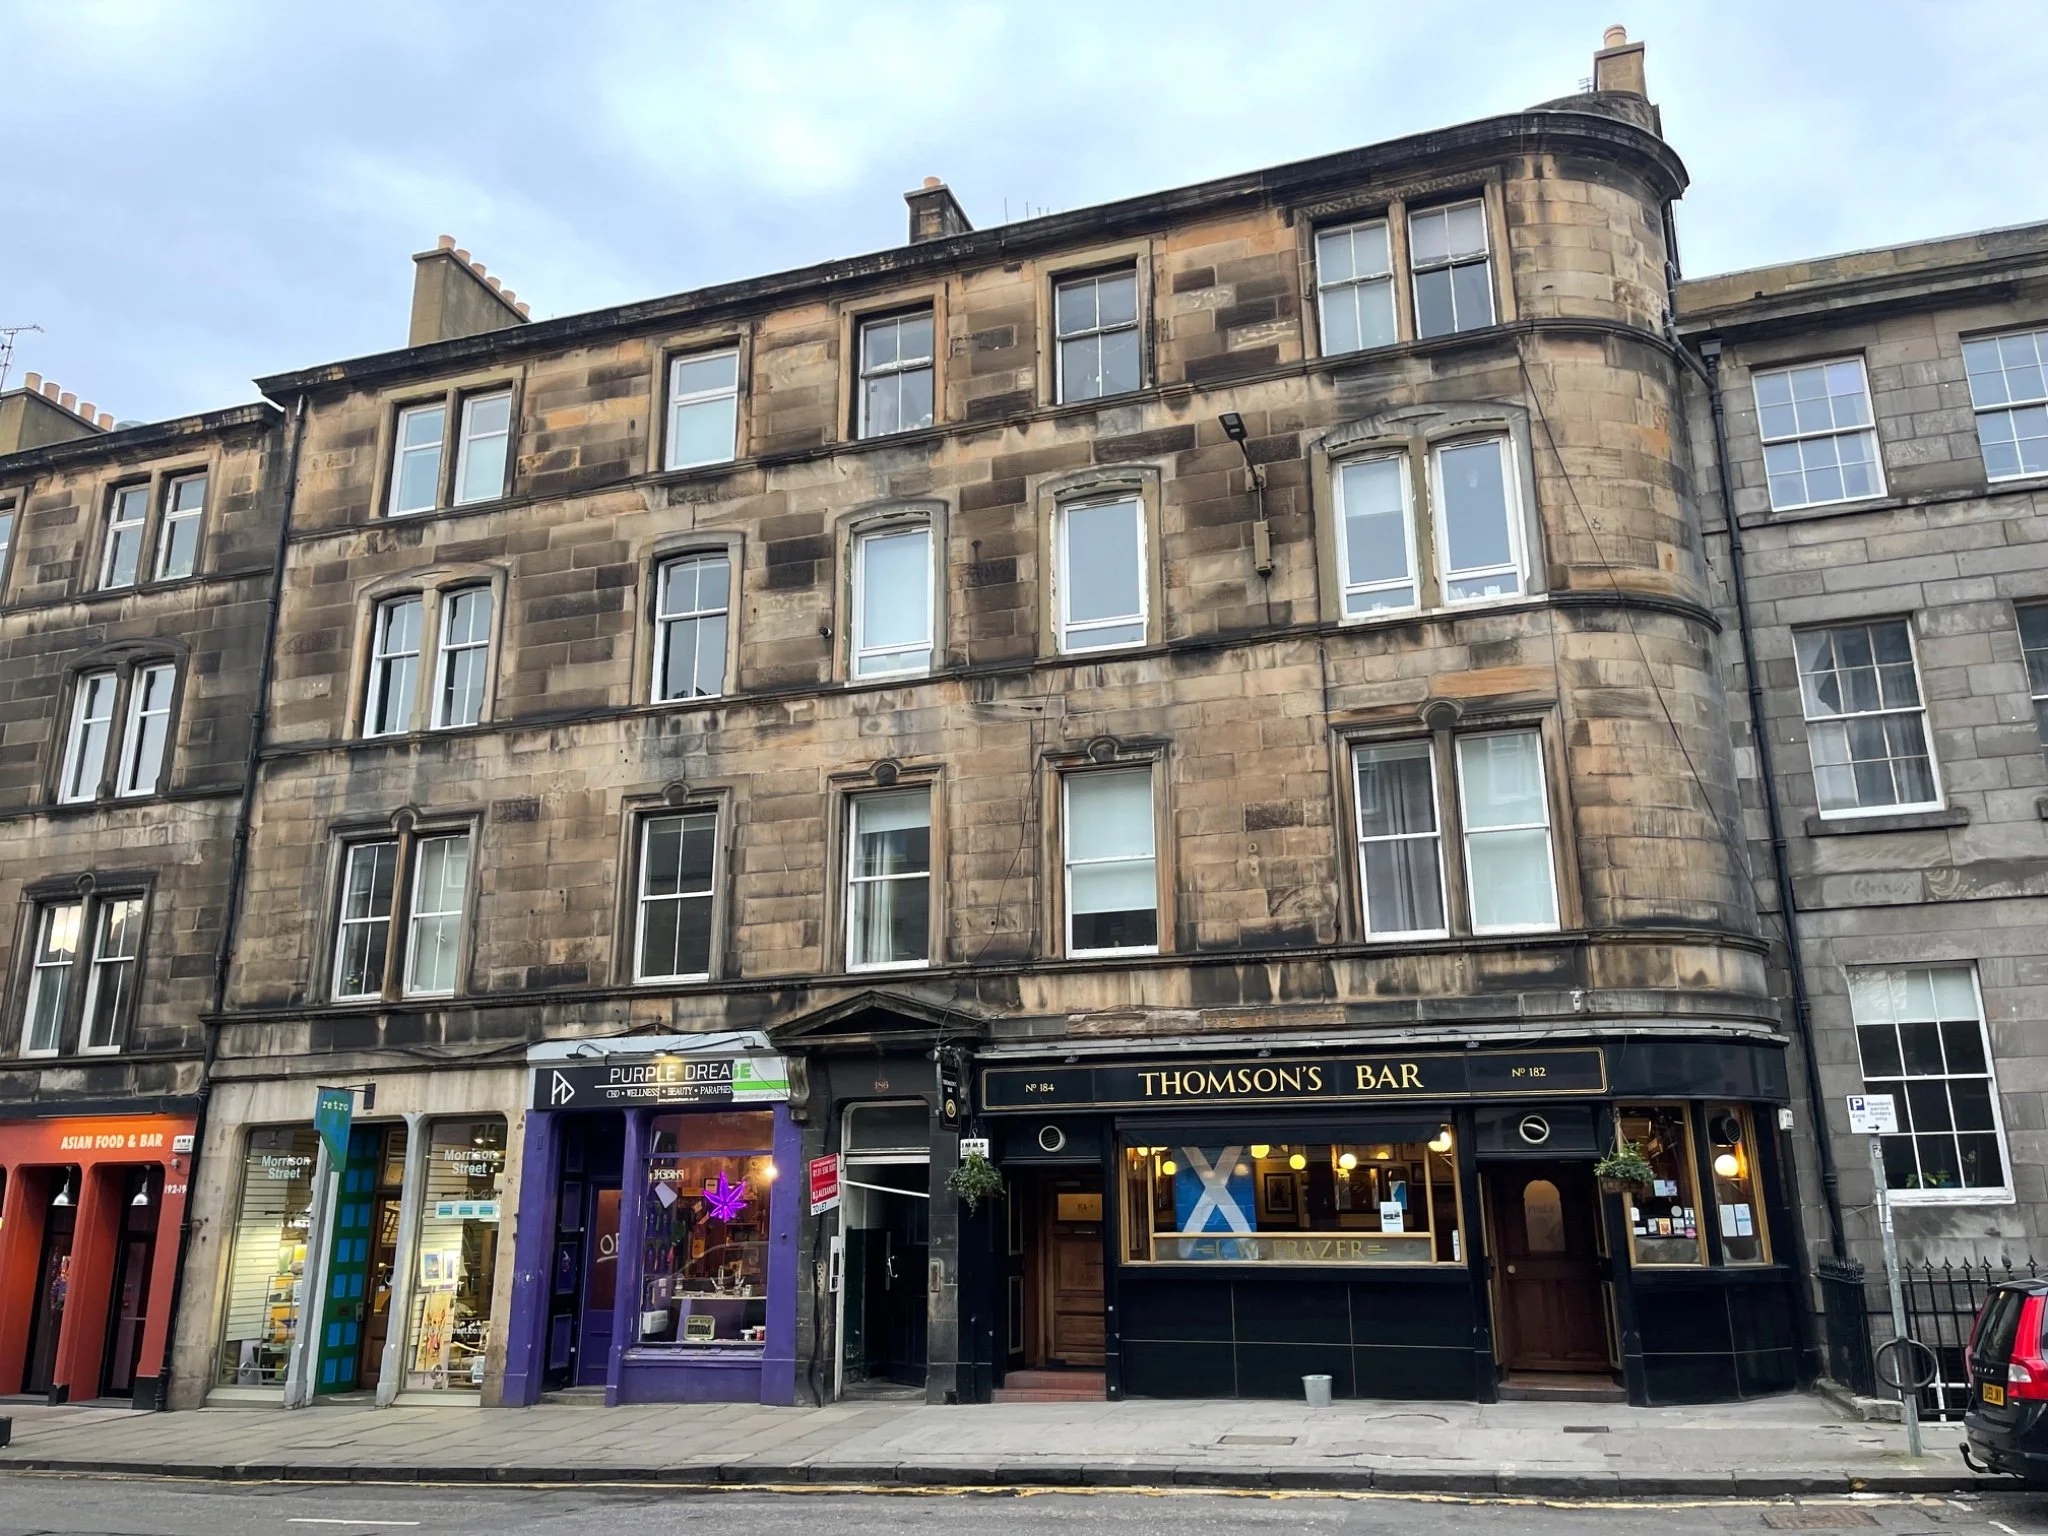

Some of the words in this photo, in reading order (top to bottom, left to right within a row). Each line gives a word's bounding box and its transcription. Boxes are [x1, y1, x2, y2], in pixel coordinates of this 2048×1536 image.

[609, 1065, 677, 1083] PURPLE
[685, 1063, 731, 1081] DREA
[1529, 1067, 1547, 1077] 182
[874, 1080, 889, 1090] 186
[1138, 1066, 1323, 1096] THOMSON'S
[1355, 1063, 1424, 1090] BAR
[626, 1087, 660, 1098] WELLNESS
[667, 1086, 693, 1096] BEAUTY
[1039, 1083, 1055, 1092] 184
[322, 1100, 349, 1112] retro
[1851, 1098, 1863, 1110] P
[60, 1136, 93, 1150] ASIAN
[95, 1135, 124, 1149] FOOD
[127, 1134, 136, 1148] &
[140, 1133, 163, 1147] BAR
[261, 1154, 311, 1167] Morrison
[444, 1148, 499, 1161] Morrison
[267, 1167, 301, 1180] Street
[451, 1162, 487, 1175] Street
[1272, 1239, 1365, 1260] FRAZER
